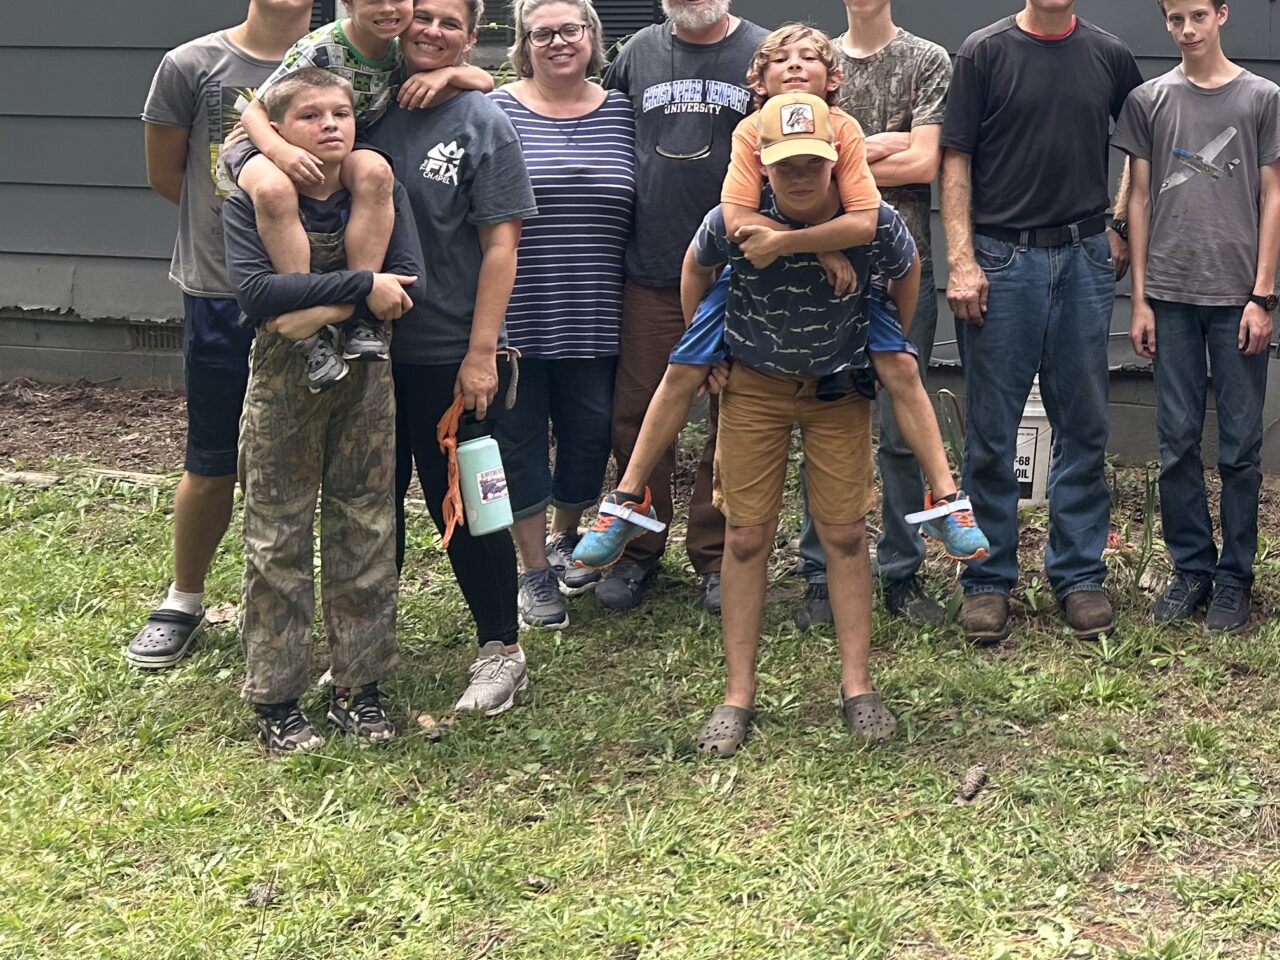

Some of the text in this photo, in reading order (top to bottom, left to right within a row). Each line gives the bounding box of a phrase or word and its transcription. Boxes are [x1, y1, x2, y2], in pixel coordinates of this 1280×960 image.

[706, 80, 751, 115] NEWPORT
[664, 103, 722, 115] UNIVERSITY
[423, 171, 450, 184] CHAPEL
[425, 158, 460, 186] FIX
[1015, 468, 1029, 479] OIL
